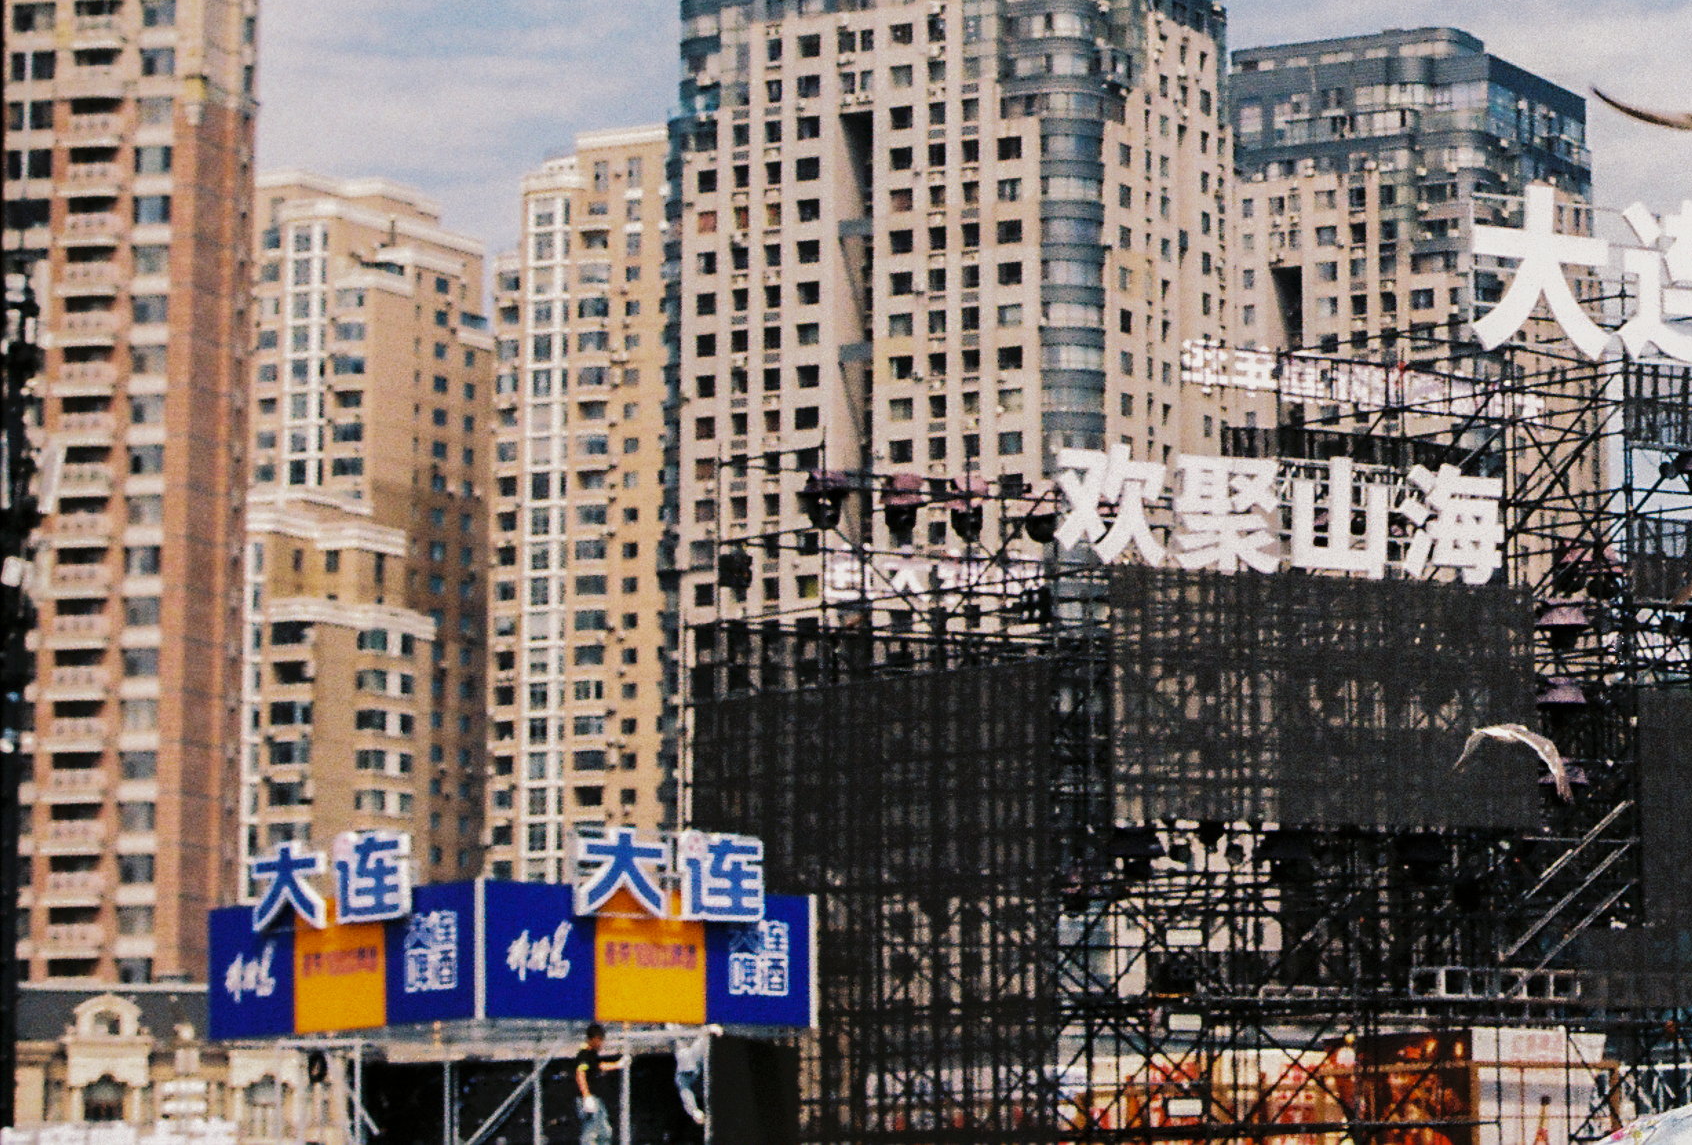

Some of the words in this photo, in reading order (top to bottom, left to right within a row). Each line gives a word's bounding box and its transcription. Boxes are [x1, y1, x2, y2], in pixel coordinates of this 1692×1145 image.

[1051, 444, 1505, 585] 欢聚山海
[252, 830, 412, 932] 大连
[574, 827, 765, 922] 大连
